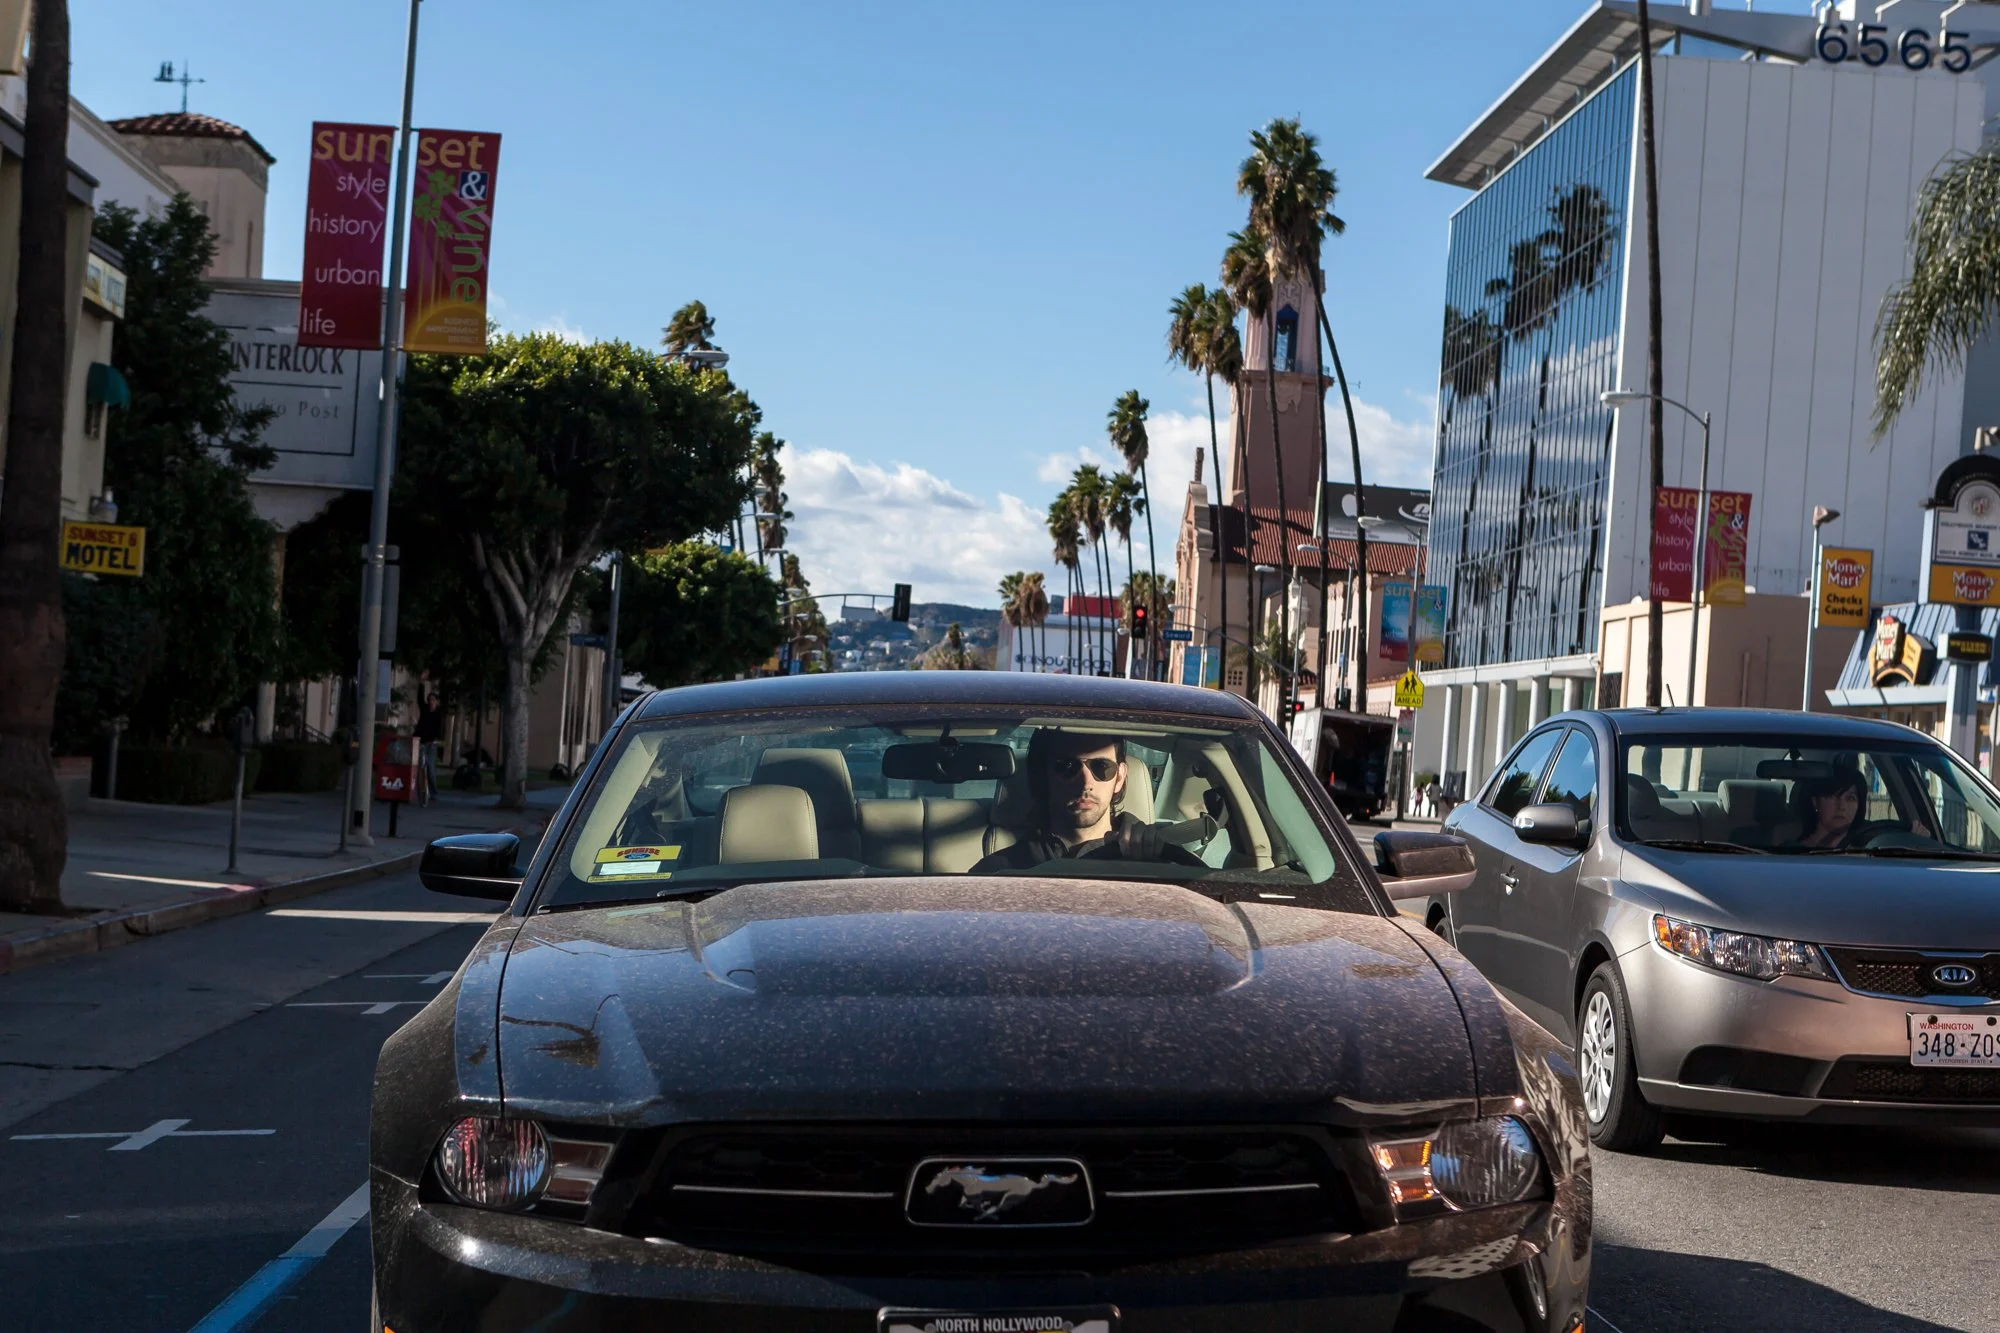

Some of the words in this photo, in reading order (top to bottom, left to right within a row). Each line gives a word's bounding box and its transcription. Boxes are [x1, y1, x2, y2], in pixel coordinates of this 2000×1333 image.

[1817, 23, 1972, 73] 6565
[418, 135, 486, 170] set
[336, 168, 386, 199] style
[461, 171, 487, 200] &
[309, 208, 383, 243] history
[450, 204, 488, 303] vine
[315, 259, 380, 285] urban
[303, 308, 336, 335] life
[230, 342, 344, 375] INTERLOCK
[299, 400, 339, 419] Post
[1669, 511, 1694, 528] style
[68, 526, 125, 544] SUNSET
[1655, 531, 1691, 550] history
[65, 542, 137, 570] MOTEL
[1658, 557, 1691, 572] urban
[1825, 559, 1866, 577] Money
[1652, 582, 1670, 597] life
[1828, 572, 1861, 588] Mart
[1952, 570, 1996, 590] Money
[1826, 593, 1863, 605] Checks
[1954, 584, 1990, 600] Mart
[1825, 604, 1864, 617] Cashed
[1397, 696, 1422, 705] AHEAD
[1940, 968, 1969, 981] KIA
[935, 1319, 979, 1332] NORTH
[983, 1316, 1063, 1332] HOLLYWOOD
